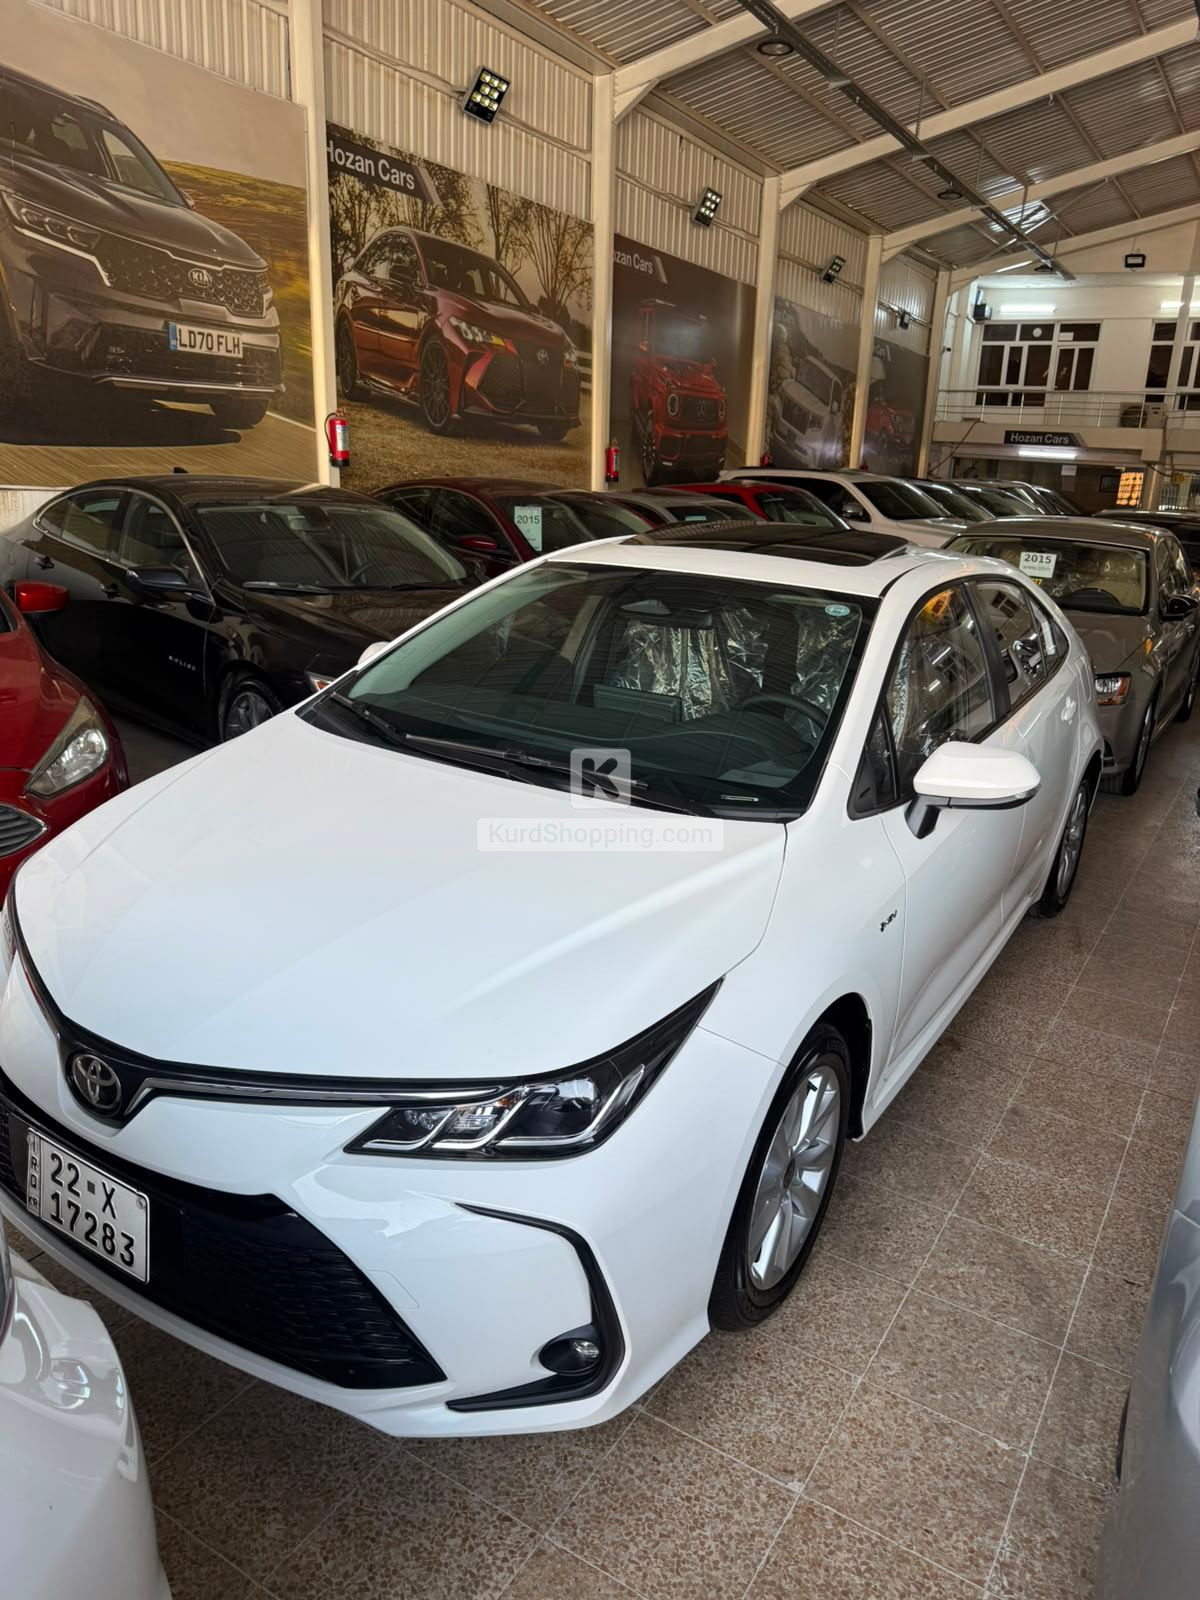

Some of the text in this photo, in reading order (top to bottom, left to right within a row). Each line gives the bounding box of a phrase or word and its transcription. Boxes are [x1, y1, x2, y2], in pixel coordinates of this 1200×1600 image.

[378, 159, 415, 190] Cars
[633, 253, 654, 274] Cars
[178, 328, 240, 354] LD70 FLH
[1010, 432, 1069, 445] Hozan Cars
[516, 514, 540, 525] 2015
[1024, 553, 1052, 564] 2015
[51, 1152, 117, 1219] 22 X
[51, 1191, 135, 1267] 17283
